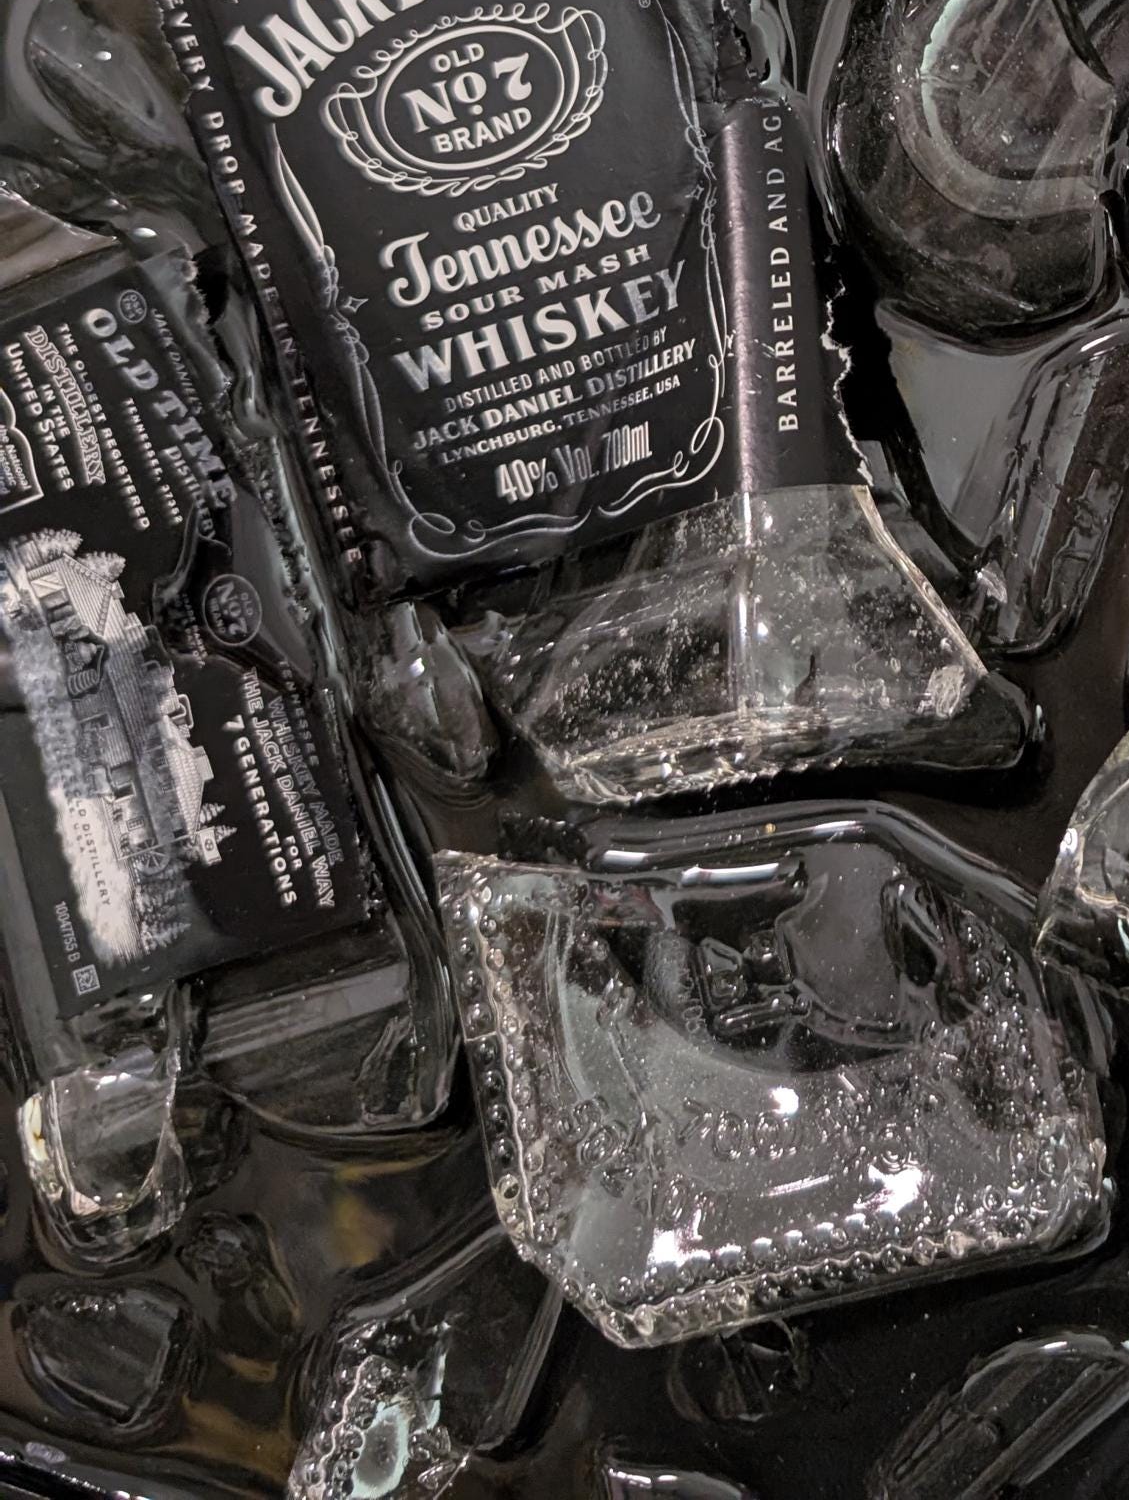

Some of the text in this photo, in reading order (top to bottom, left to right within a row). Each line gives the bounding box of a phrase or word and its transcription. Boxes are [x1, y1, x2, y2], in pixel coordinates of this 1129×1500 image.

[434, 42, 486, 73] OLD
[431, 106, 533, 154] BRAND
[379, 190, 662, 308] Tennessee
[454, 182, 559, 233] QUALITY
[766, 167, 789, 233] AND
[151, 308, 177, 349] JACK
[202, 111, 247, 194] DROP
[236, 213, 280, 302] MADE
[274, 321, 297, 357] IN
[292, 371, 363, 565] TENNESSEE
[391, 259, 687, 393] WHISKEY
[420, 243, 652, 332] SOUR MASH
[444, 326, 668, 414] DISTILLED AND BOTTLED BY
[655, 373, 682, 395] USA
[770, 246, 800, 432] BARRELED
[7, 341, 76, 492] UNITED STATES
[23, 324, 107, 485] DISTILLERY
[41, 383, 72, 438] IN THE
[56, 322, 151, 529] THE OLDEST REGISTERED
[83, 307, 238, 509] OLD TIME
[413, 337, 697, 450] JACK DANIEL DISTILLERY
[163, 445, 217, 540] DISTILLERY
[494, 457, 559, 505] 40%
[279, 660, 320, 767] TENNESSEE
[223, 714, 298, 906] 7 GENERATIONS
[242, 665, 336, 909] THE JACK DANIEL WAY
[268, 694, 345, 867] WHISKEY MADE
[82, 823, 112, 907] DISTILLERY
[285, 835, 303, 870] FOR
